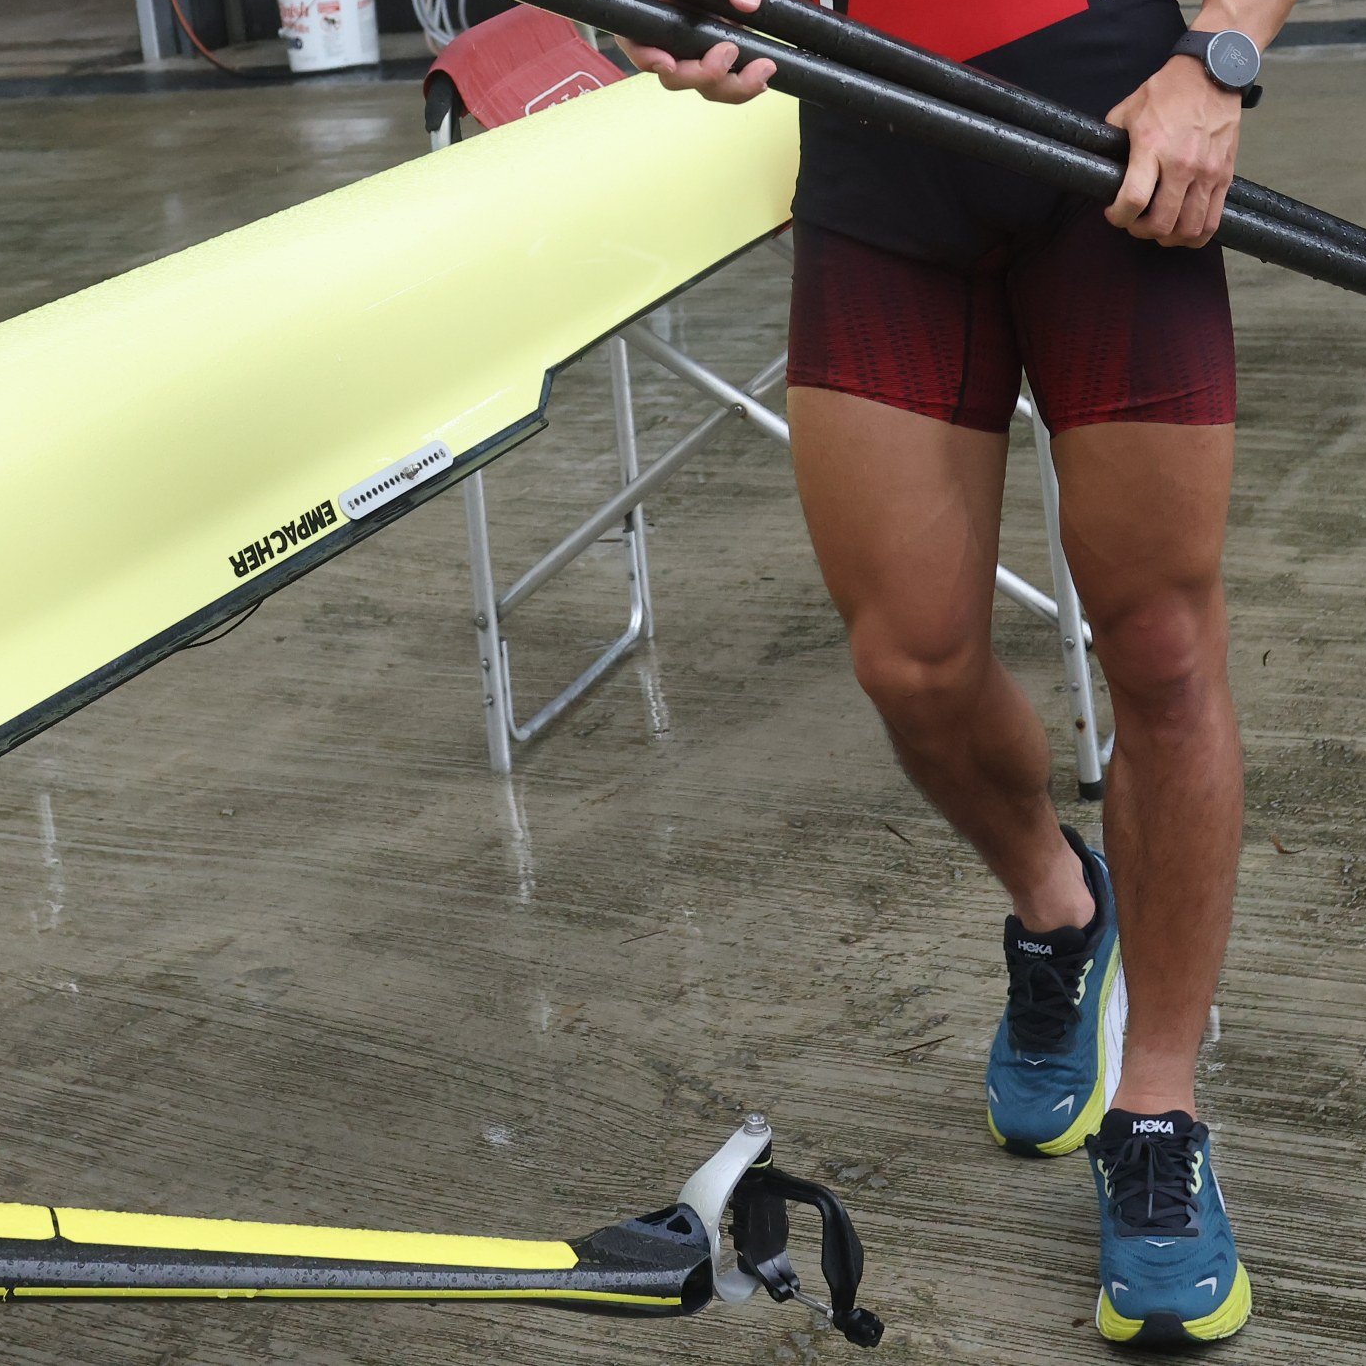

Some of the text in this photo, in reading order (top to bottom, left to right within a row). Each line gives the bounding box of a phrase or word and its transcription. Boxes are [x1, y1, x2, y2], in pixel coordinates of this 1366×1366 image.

[229, 500, 338, 578] EMPACHER
[1017, 939, 1053, 955] HOKA
[1132, 1119, 1175, 1135] HOKA
